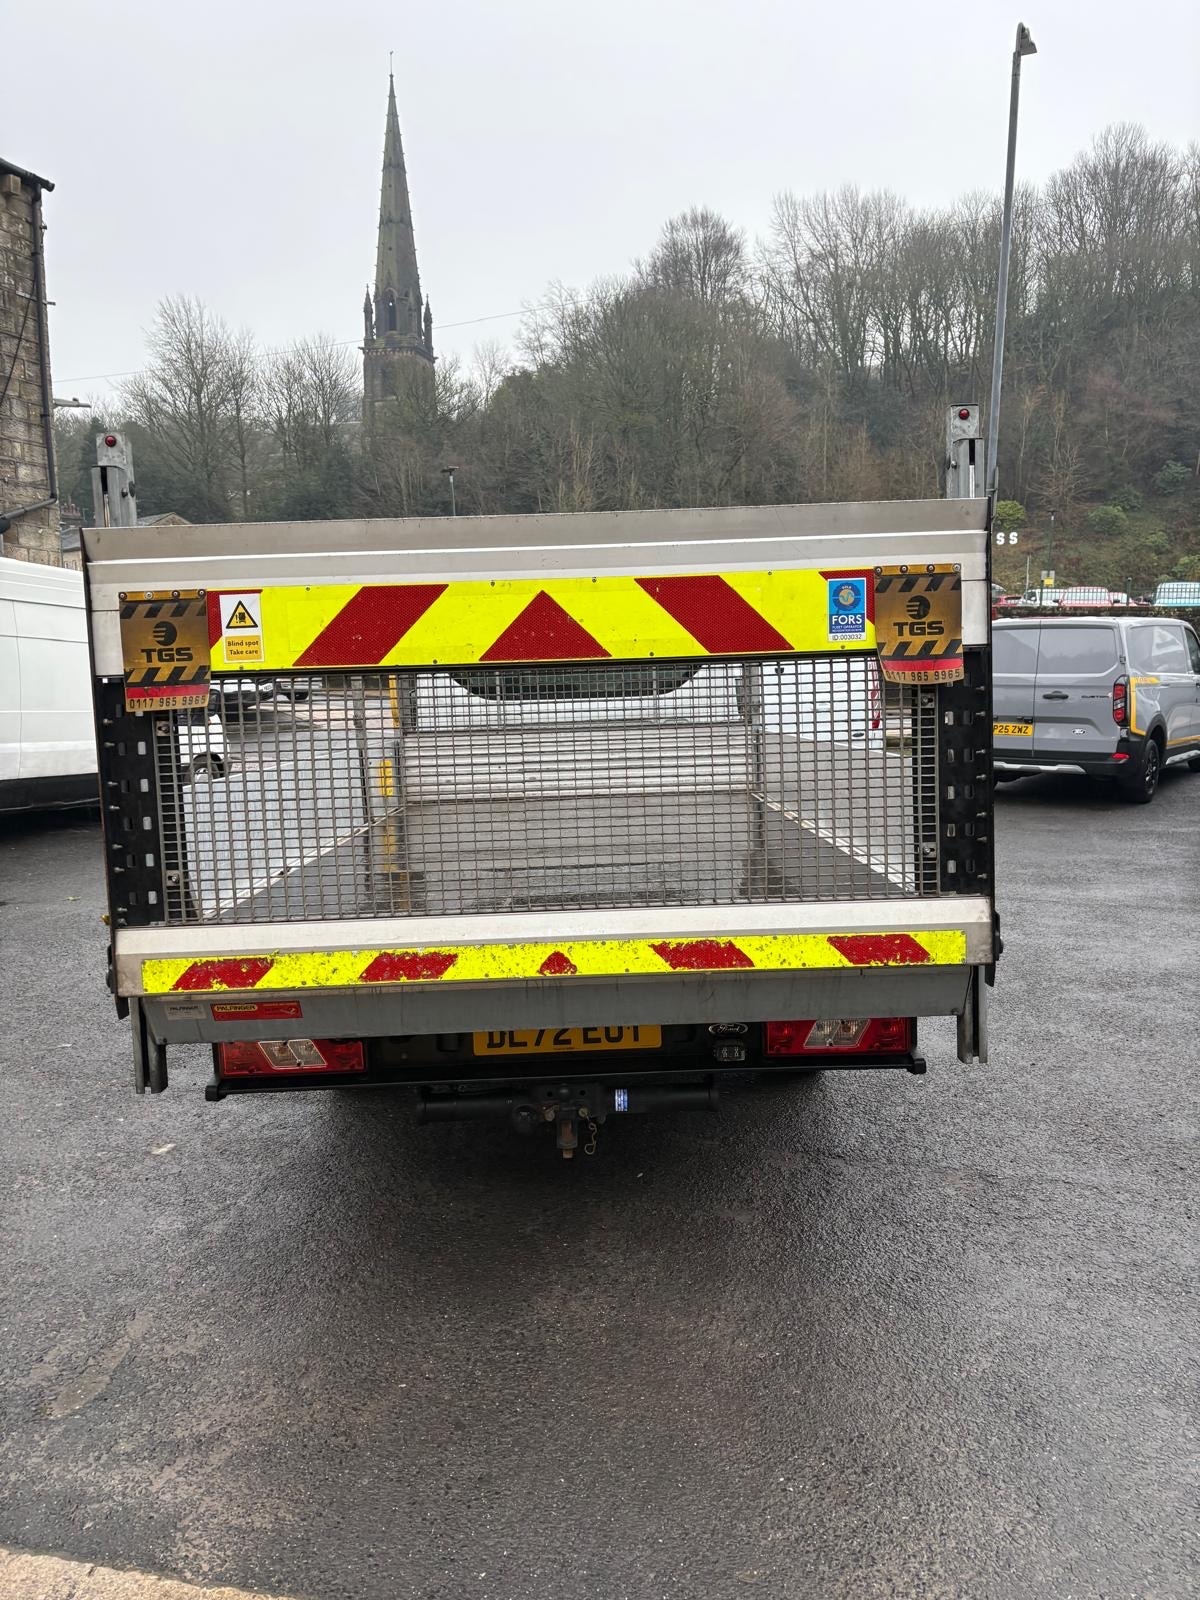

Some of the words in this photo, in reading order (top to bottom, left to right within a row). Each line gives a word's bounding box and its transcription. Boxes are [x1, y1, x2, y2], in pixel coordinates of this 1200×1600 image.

[832, 614, 862, 625] FORS
[893, 620, 944, 636] TGS
[244, 640, 259, 648] spot
[141, 647, 193, 663] TGS
[885, 670, 906, 681] 0117
[911, 671, 929, 681] 965
[934, 669, 960, 680] 9965
[129, 698, 154, 708] 0117
[159, 697, 177, 707] 965
[182, 695, 206, 705] 9965
